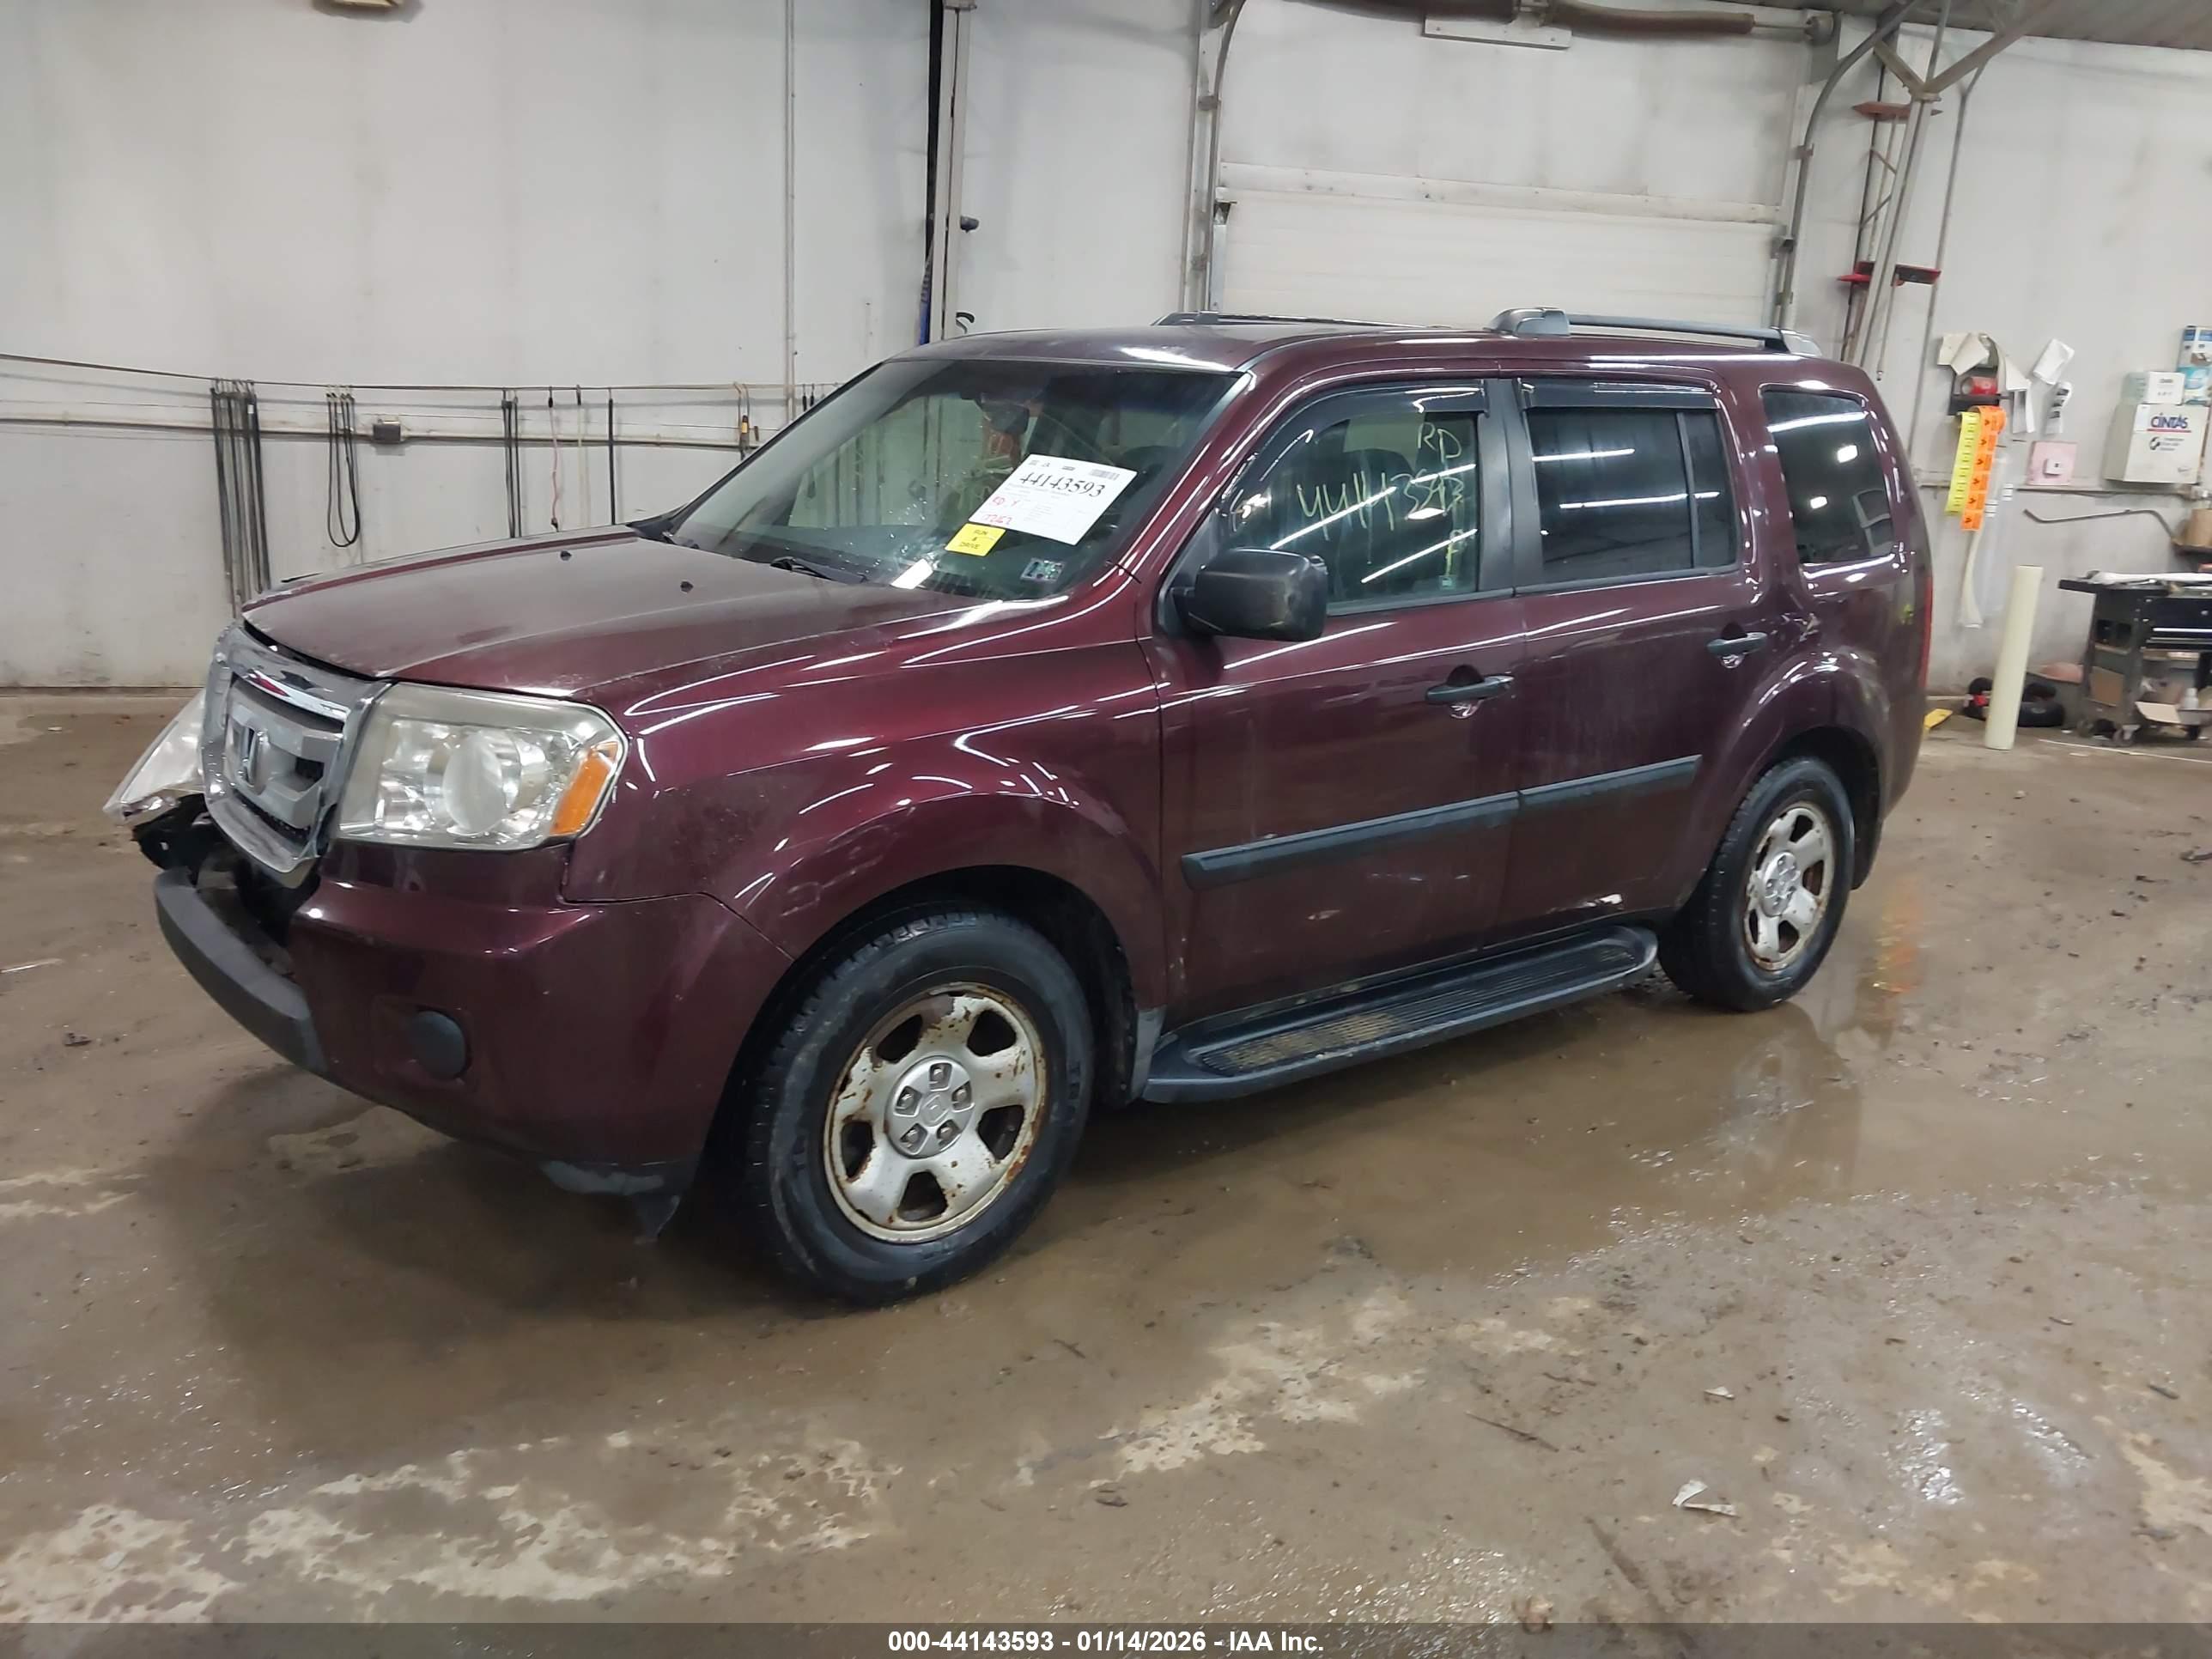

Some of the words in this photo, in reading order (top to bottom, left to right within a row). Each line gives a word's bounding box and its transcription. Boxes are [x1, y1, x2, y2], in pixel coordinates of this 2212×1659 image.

[2151, 412, 2189, 429] CINTAS
[1019, 471, 1106, 498] 44143593
[959, 542, 980, 550] DRIVE
